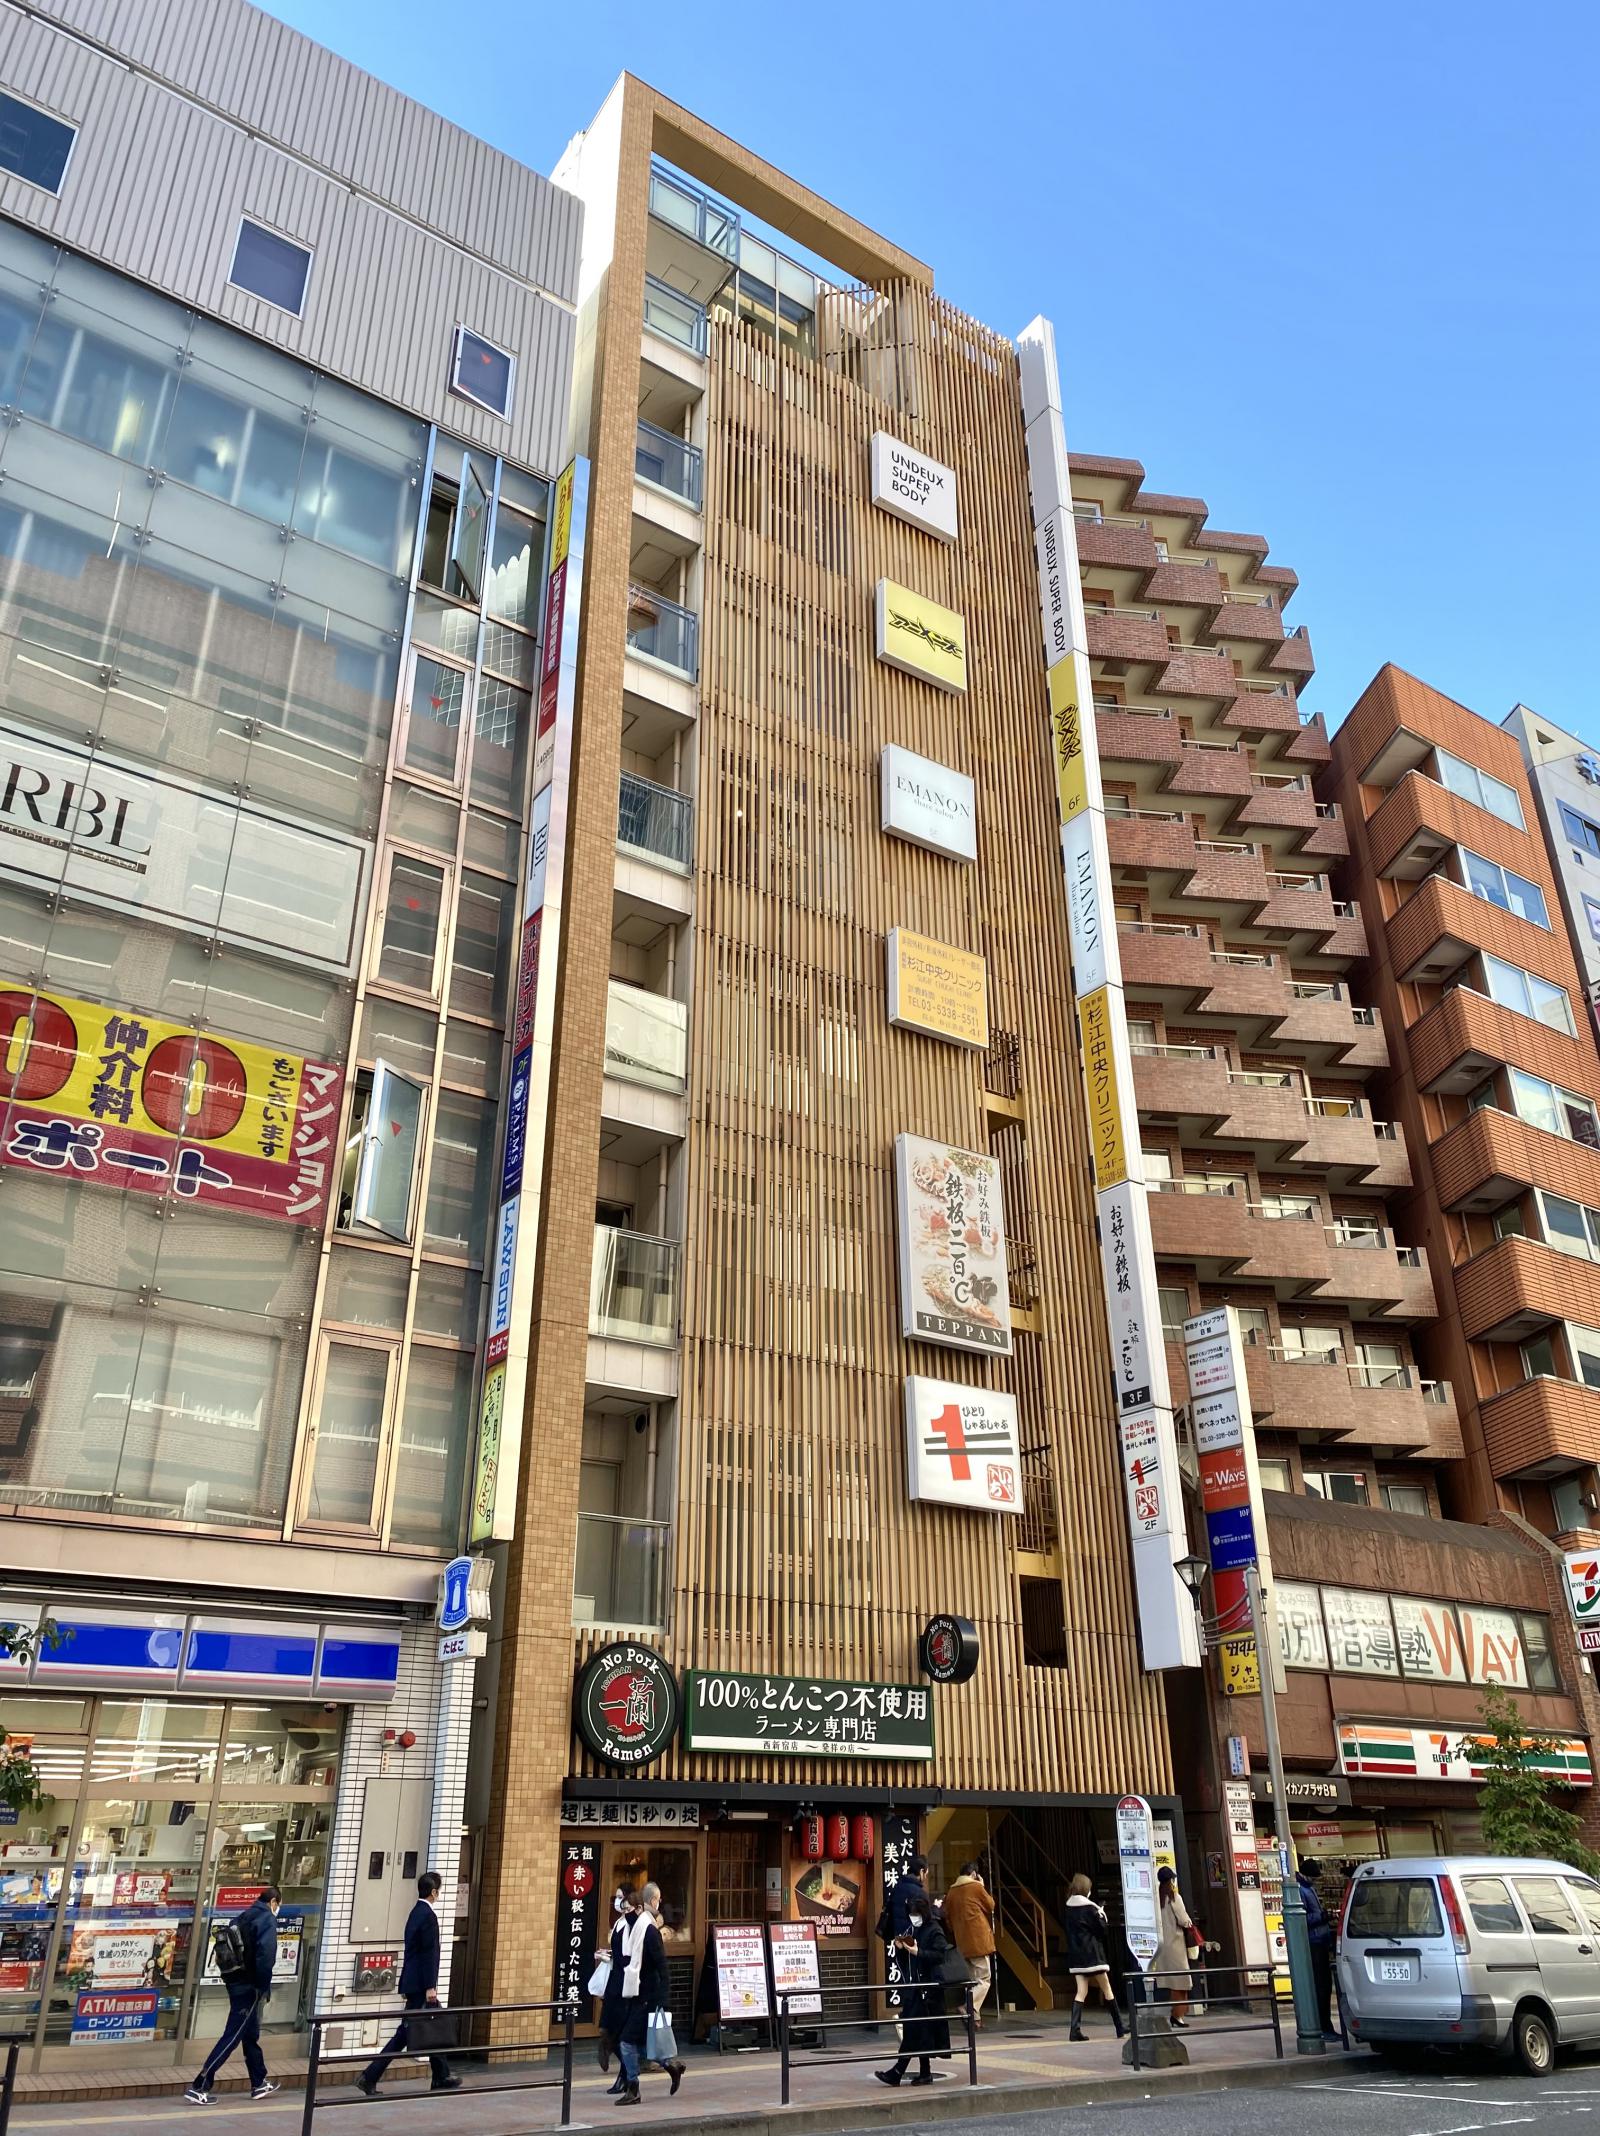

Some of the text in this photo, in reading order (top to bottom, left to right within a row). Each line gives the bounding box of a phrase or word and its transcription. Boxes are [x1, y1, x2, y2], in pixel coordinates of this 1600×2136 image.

[891, 450, 944, 489] UNDEUX
[892, 466, 930, 495] SUPER
[892, 480, 927, 506] BODY
[1044, 520, 1066, 653] UNDEUX SUPER BODY
[0, 761, 152, 857] RBL
[897, 775, 970, 819] EMANON
[1068, 795, 1081, 810] 6F
[1077, 850, 1100, 953] EMANON
[907, 956, 982, 993] 杉江中央クリニック
[89, 1015, 149, 1124] 仲介料
[1087, 1007, 1117, 1159] 杉江中央クリニック
[256, 1058, 295, 1158] もございます
[285, 1062, 340, 1217] マンション
[510, 1100, 522, 1166] PALMS
[5, 1119, 233, 1197] ポート
[976, 1169, 992, 1239] お好み鉄板
[1110, 1204, 1132, 1293] お好み鉄板
[496, 1202, 516, 1331] LAWSON
[922, 1314, 1002, 1345] TEPPAN
[488, 1336, 508, 1357] たばこ
[961, 1405, 985, 1417] ひとり
[1129, 1391, 1144, 1405] 3F
[964, 1418, 1009, 1431] しゃぶしゃぶ
[1144, 1519, 1158, 1532] 2F
[930, 1619, 953, 1635] No Pork
[442, 1640, 464, 1655] たばこ
[601, 1648, 660, 1675] No Pork
[934, 1667, 955, 1679] Ramen
[599, 1675, 655, 1732] 一蘭
[696, 1676, 928, 1721] 100%とんこつ不使用
[755, 1714, 878, 1743] ラーメン専門店
[601, 1738, 654, 1761] Ramen
[762, 1739, 799, 1751] 西新宿店
[561, 1803, 699, 1824] 超生麺15秒の掟
[839, 1815, 847, 1854] ラーメン
[567, 1846, 594, 1861] 元祖
[837, 1914, 854, 1925] New
[98, 1950, 148, 1960] 鬼滅の刃グッズを
[88, 2015, 144, 2028] ローソン銀行
